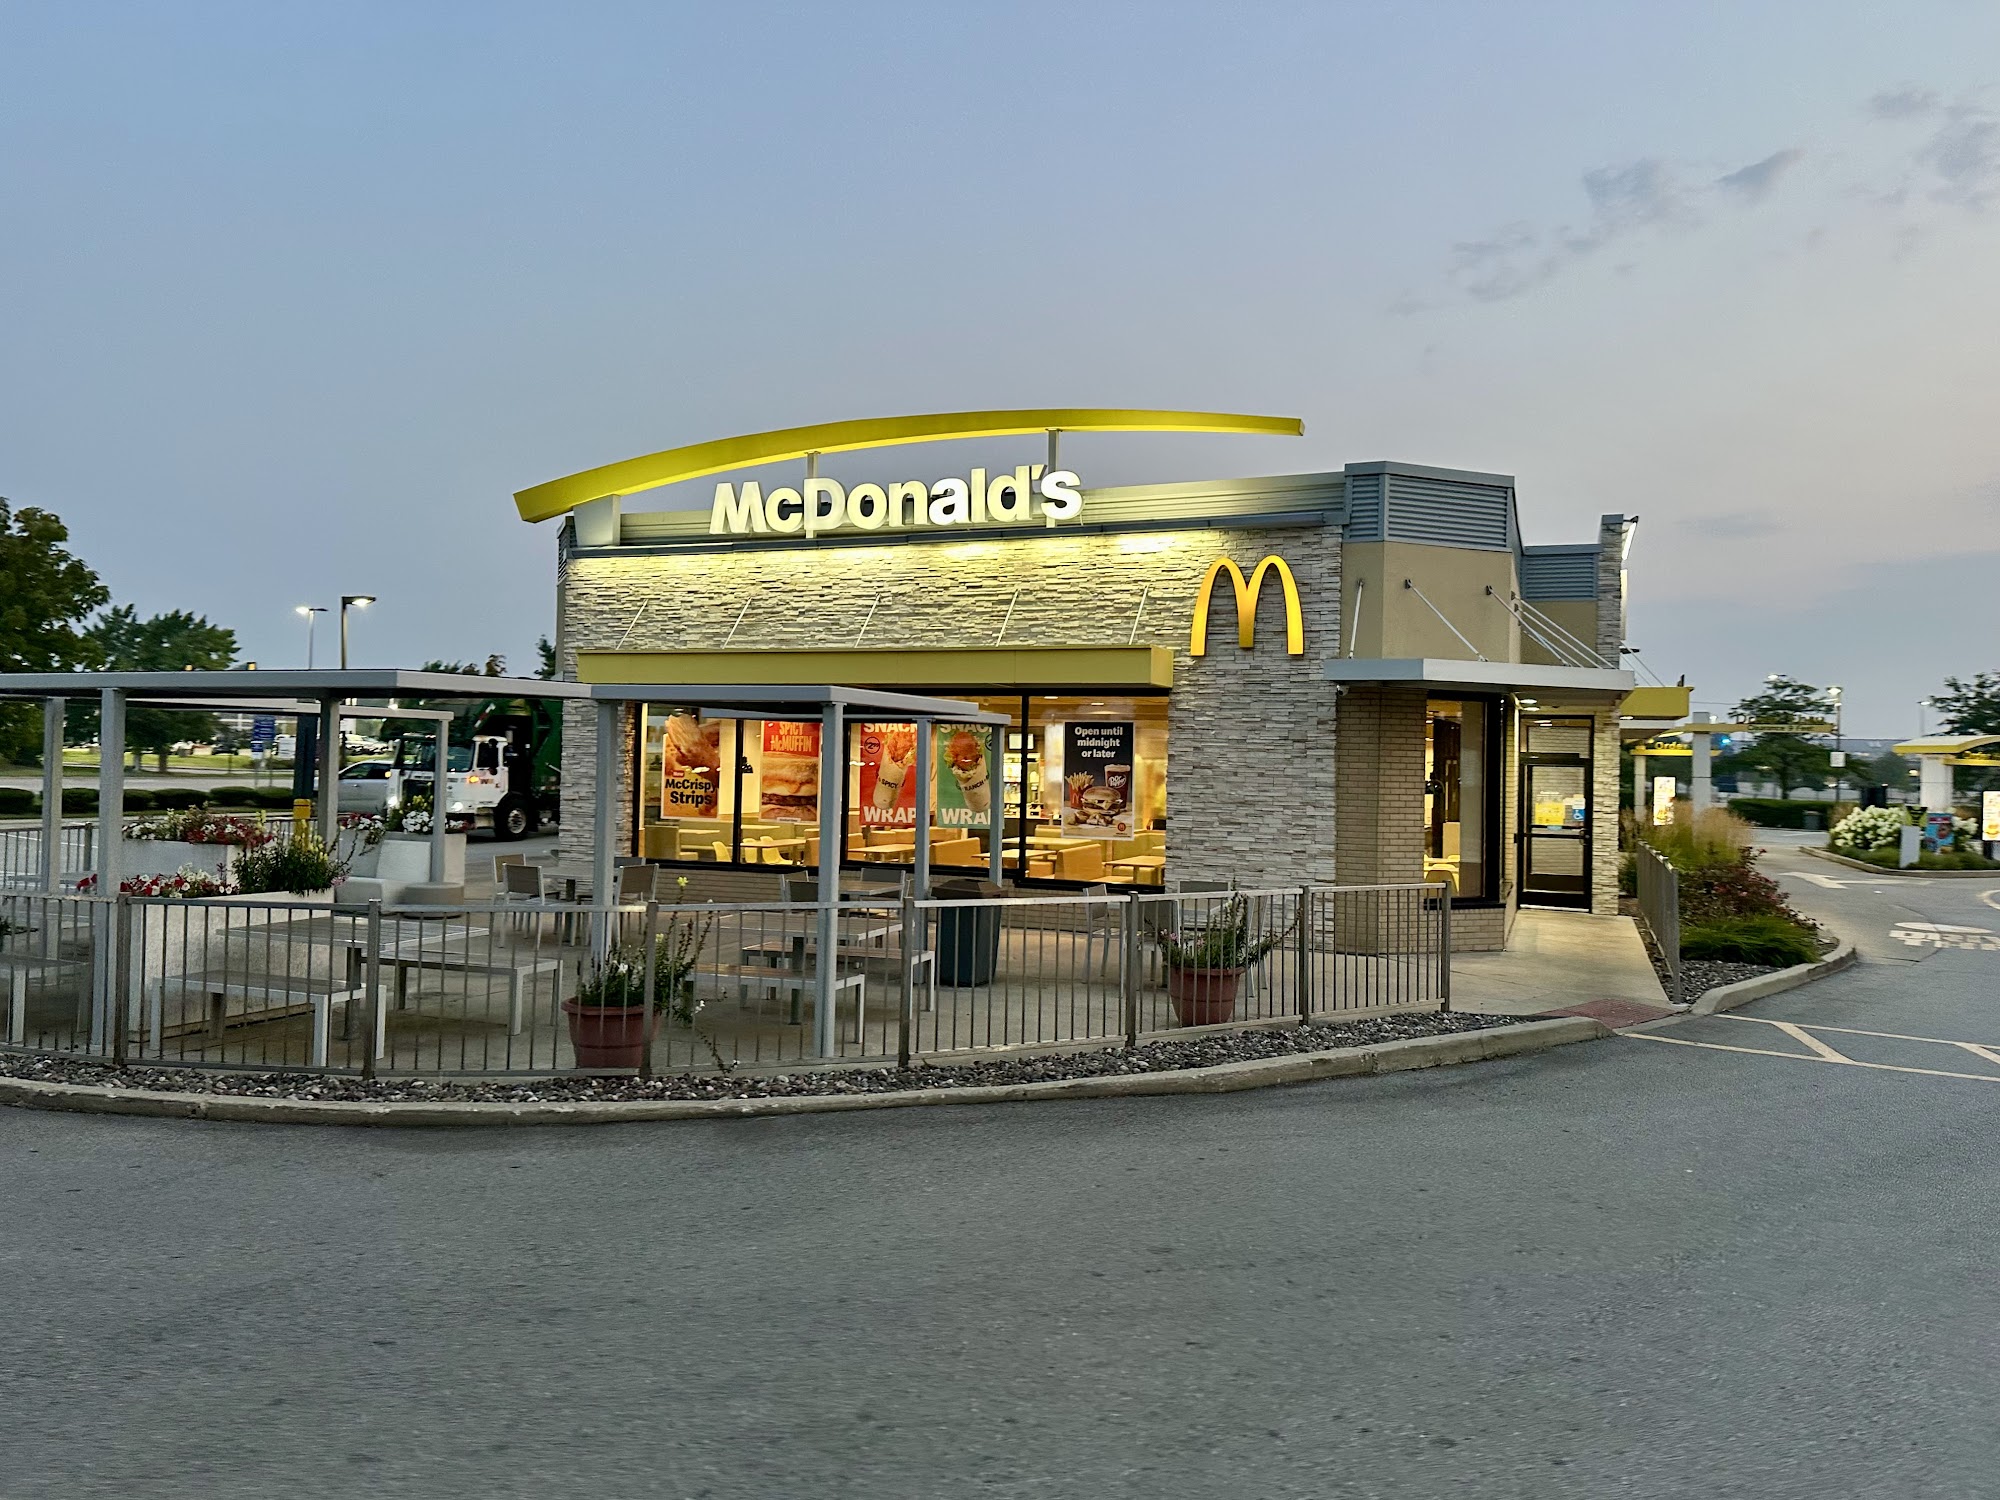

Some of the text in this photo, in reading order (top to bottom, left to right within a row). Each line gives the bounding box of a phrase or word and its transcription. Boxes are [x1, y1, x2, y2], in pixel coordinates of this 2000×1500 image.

[709, 464, 1084, 534] McDonald's
[779, 721, 804, 734] SPICY
[863, 723, 917, 733] SNAC
[940, 723, 992, 733] SNAC
[1074, 725, 1123, 737] Open until
[1077, 737, 1120, 749] midnight
[1081, 748, 1116, 758] or later
[665, 778, 718, 793] McCrispy
[881, 778, 899, 789] SPICY
[670, 790, 713, 808] Strips
[941, 808, 991, 825] WRA
